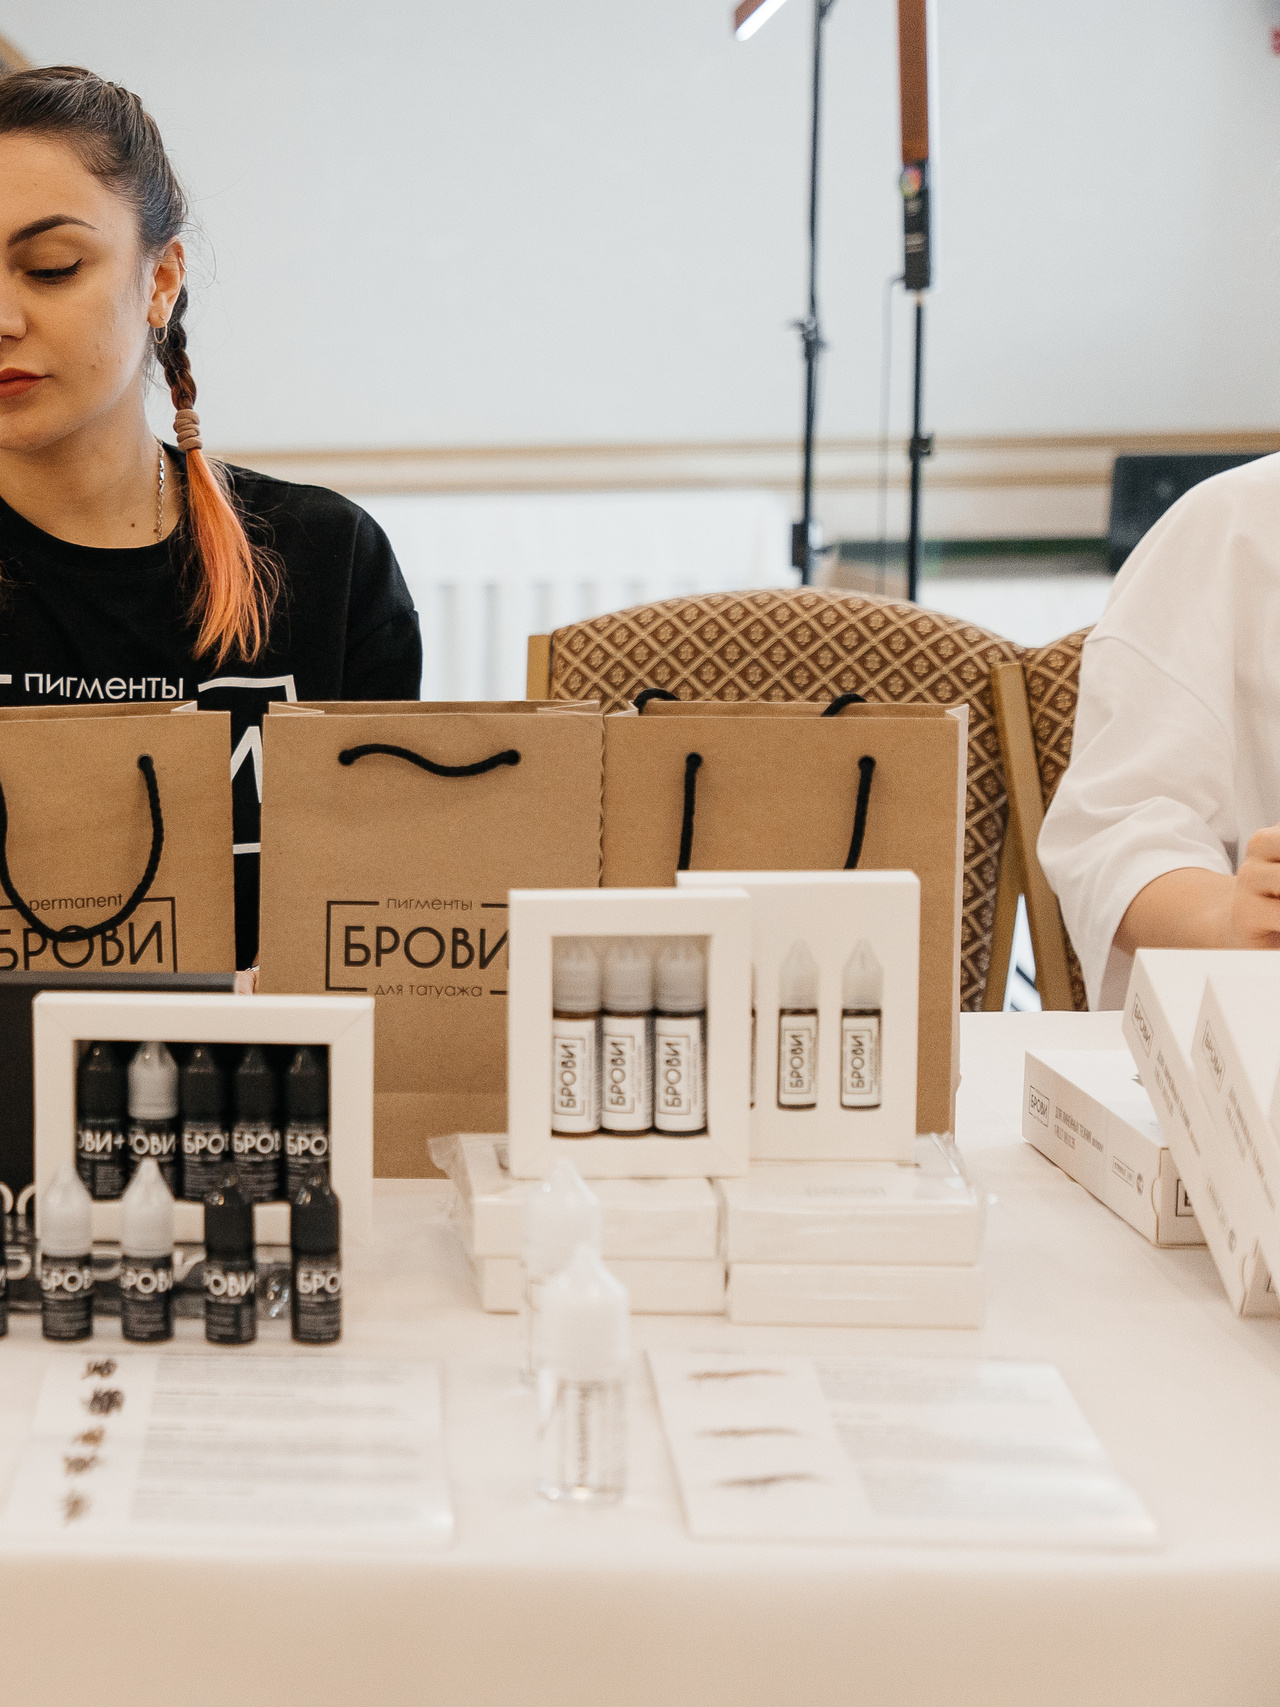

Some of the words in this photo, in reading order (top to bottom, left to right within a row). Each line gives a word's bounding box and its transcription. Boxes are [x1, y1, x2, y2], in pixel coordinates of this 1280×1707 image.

[28, 893, 123, 912] permanent
[344, 925, 510, 969] БРОВИ
[409, 984, 483, 998] татуажа
[560, 1043, 577, 1108] БРОВИ
[610, 1041, 626, 1106] БРОВИ
[664, 1042, 682, 1107] БРОВИ
[789, 1034, 804, 1088] БРОВИ
[851, 1034, 865, 1088] БРОВИ
